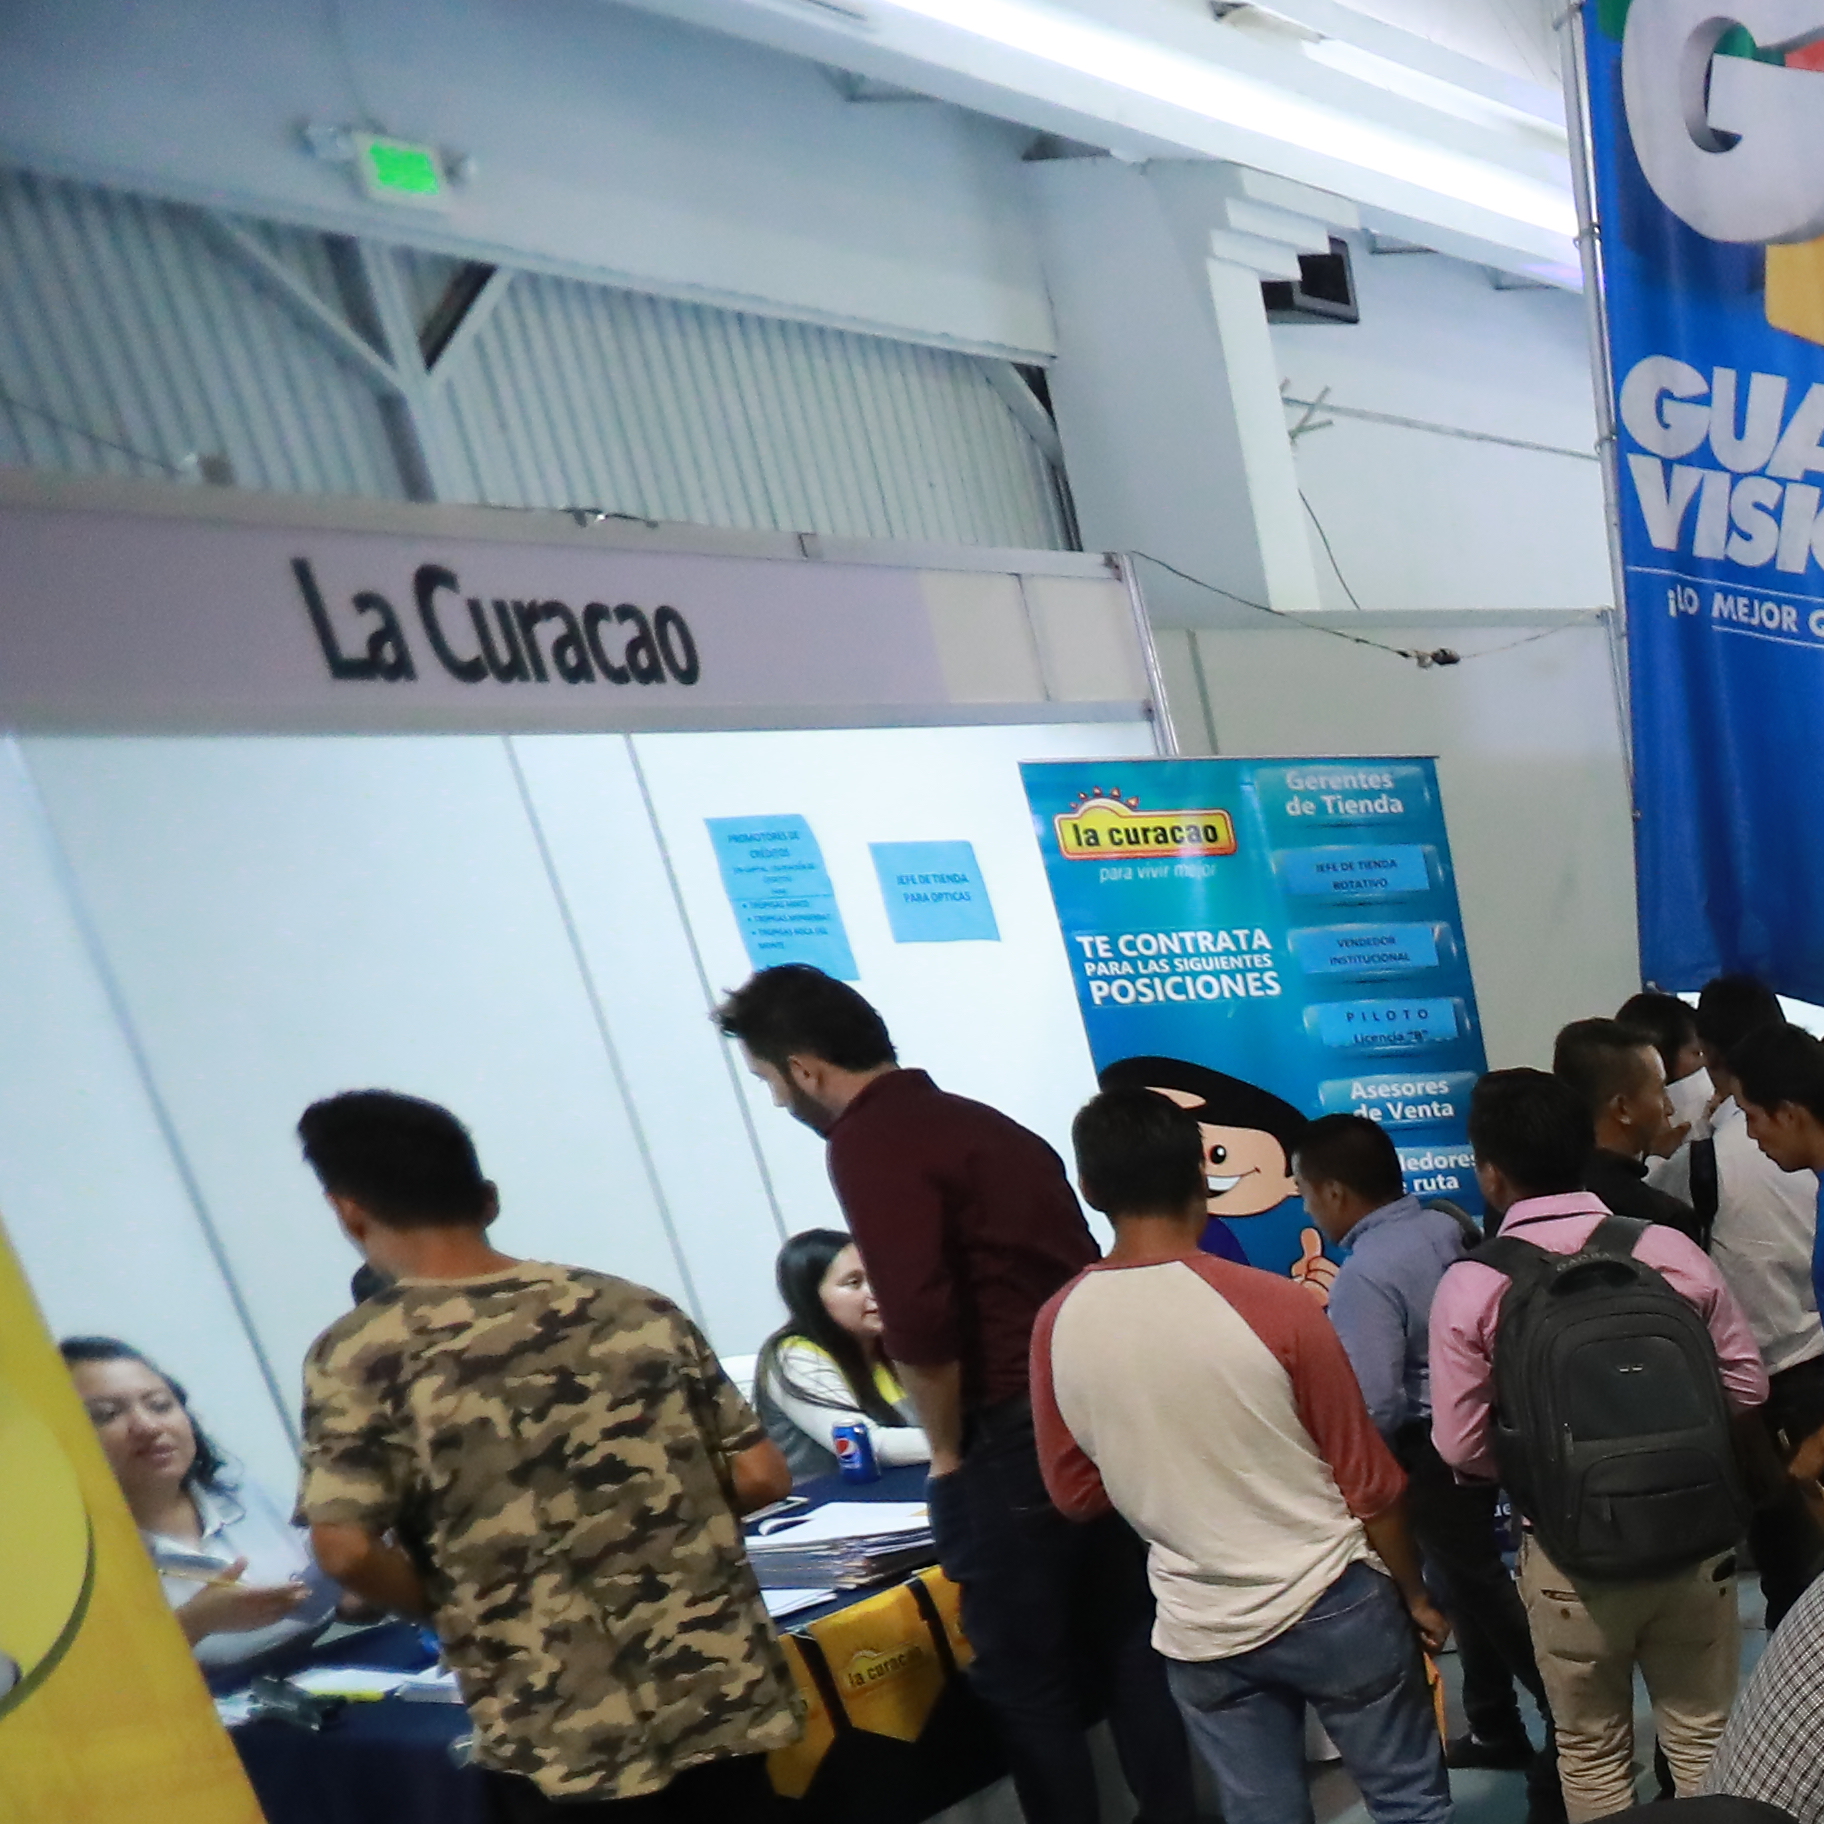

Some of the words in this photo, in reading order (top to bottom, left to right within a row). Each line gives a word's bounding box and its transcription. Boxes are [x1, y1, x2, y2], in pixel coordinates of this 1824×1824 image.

[291, 556, 417, 683] La
[414, 563, 701, 686] Curacao
[1667, 585, 1700, 619] ¡LO
[1711, 593, 1799, 635] MEJOR
[1285, 770, 1395, 790] Gerentes
[1286, 795, 1316, 816] de
[1321, 794, 1404, 816] Tienda
[1073, 823, 1101, 848] la
[1107, 823, 1220, 848] curacao
[1100, 865, 1138, 884] para
[1140, 862, 1169, 880] vivir
[1358, 859, 1397, 871] TIENDA
[1333, 878, 1388, 891] ROTATIVO
[1076, 934, 1114, 960] TE
[1122, 928, 1273, 957] CONTRATA
[1337, 936, 1396, 948] VENDEDOR
[1084, 959, 1134, 977] PARA
[1136, 958, 1171, 975] LAS
[1174, 953, 1273, 974] SIGUIENTES
[1329, 951, 1411, 965] INSTITUCIONAL
[1088, 971, 1282, 1006] POSICIONES
[1353, 1031, 1404, 1045] Licencia
[1350, 1079, 1450, 1101] Asesores
[1388, 1099, 1455, 1122] Venta
[1414, 1170, 1459, 1190] ruta
